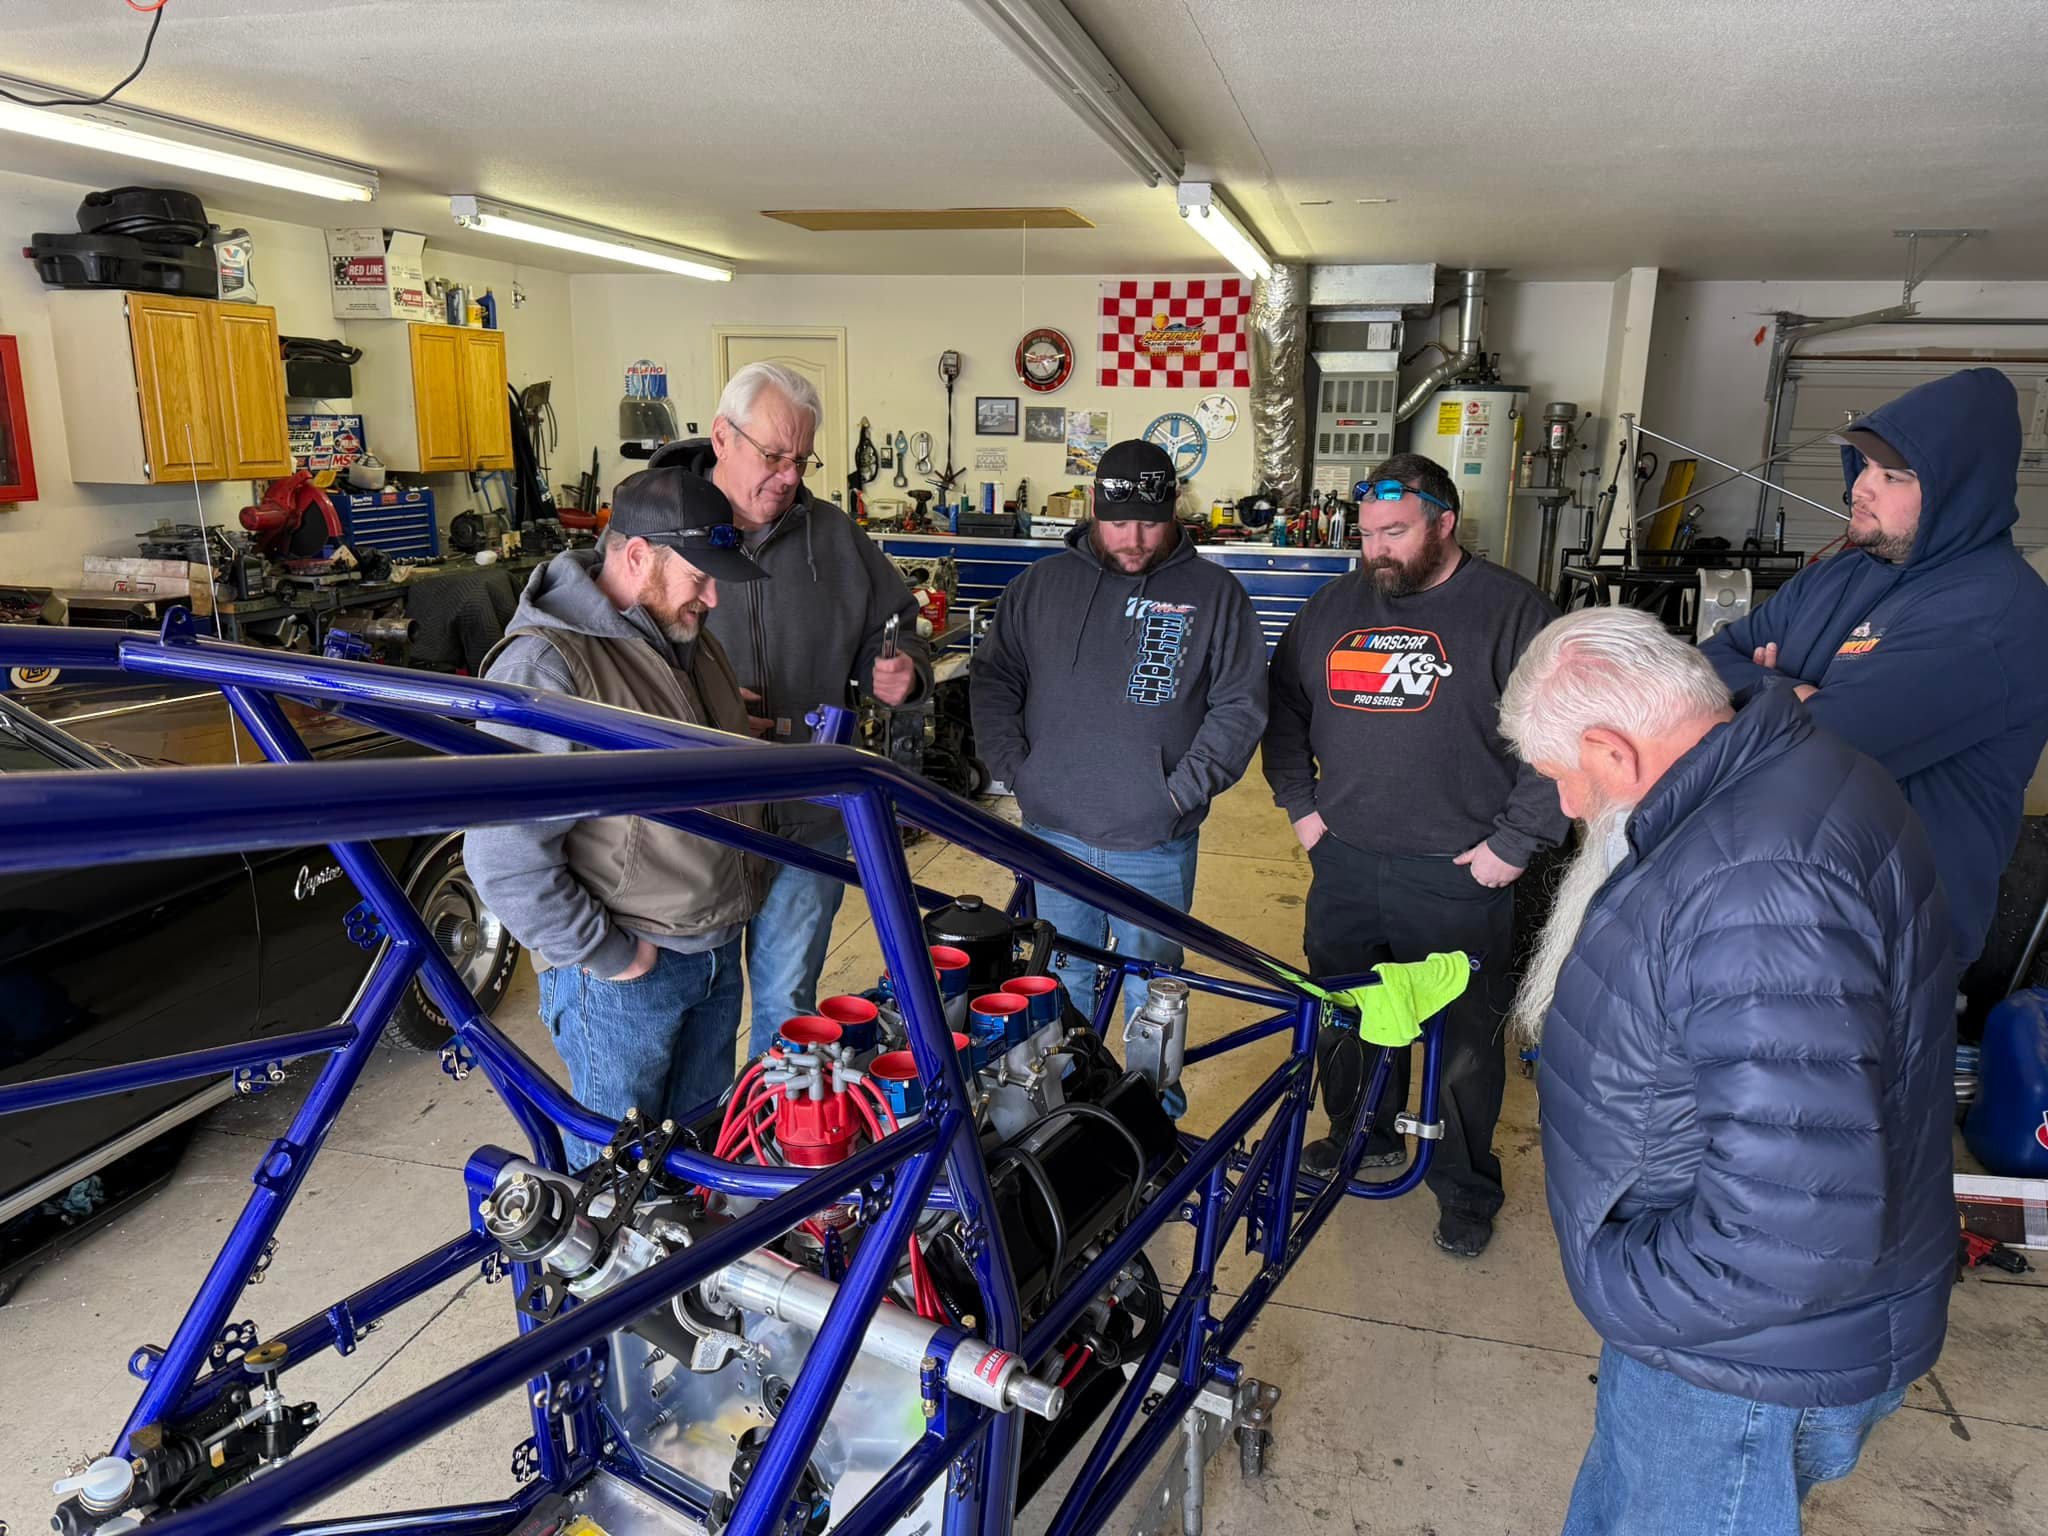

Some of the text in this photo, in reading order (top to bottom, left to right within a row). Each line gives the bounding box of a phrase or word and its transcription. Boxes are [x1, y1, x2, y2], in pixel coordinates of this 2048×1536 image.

[348, 264, 364, 276] RED
[366, 264, 384, 276] LINE
[403, 293, 422, 301] RED LINE
[1125, 597, 1153, 620] 77
[1369, 635, 1429, 650] NASCAR
[1353, 694, 1405, 707] PRO SERIES
[294, 864, 344, 900] Caprice
